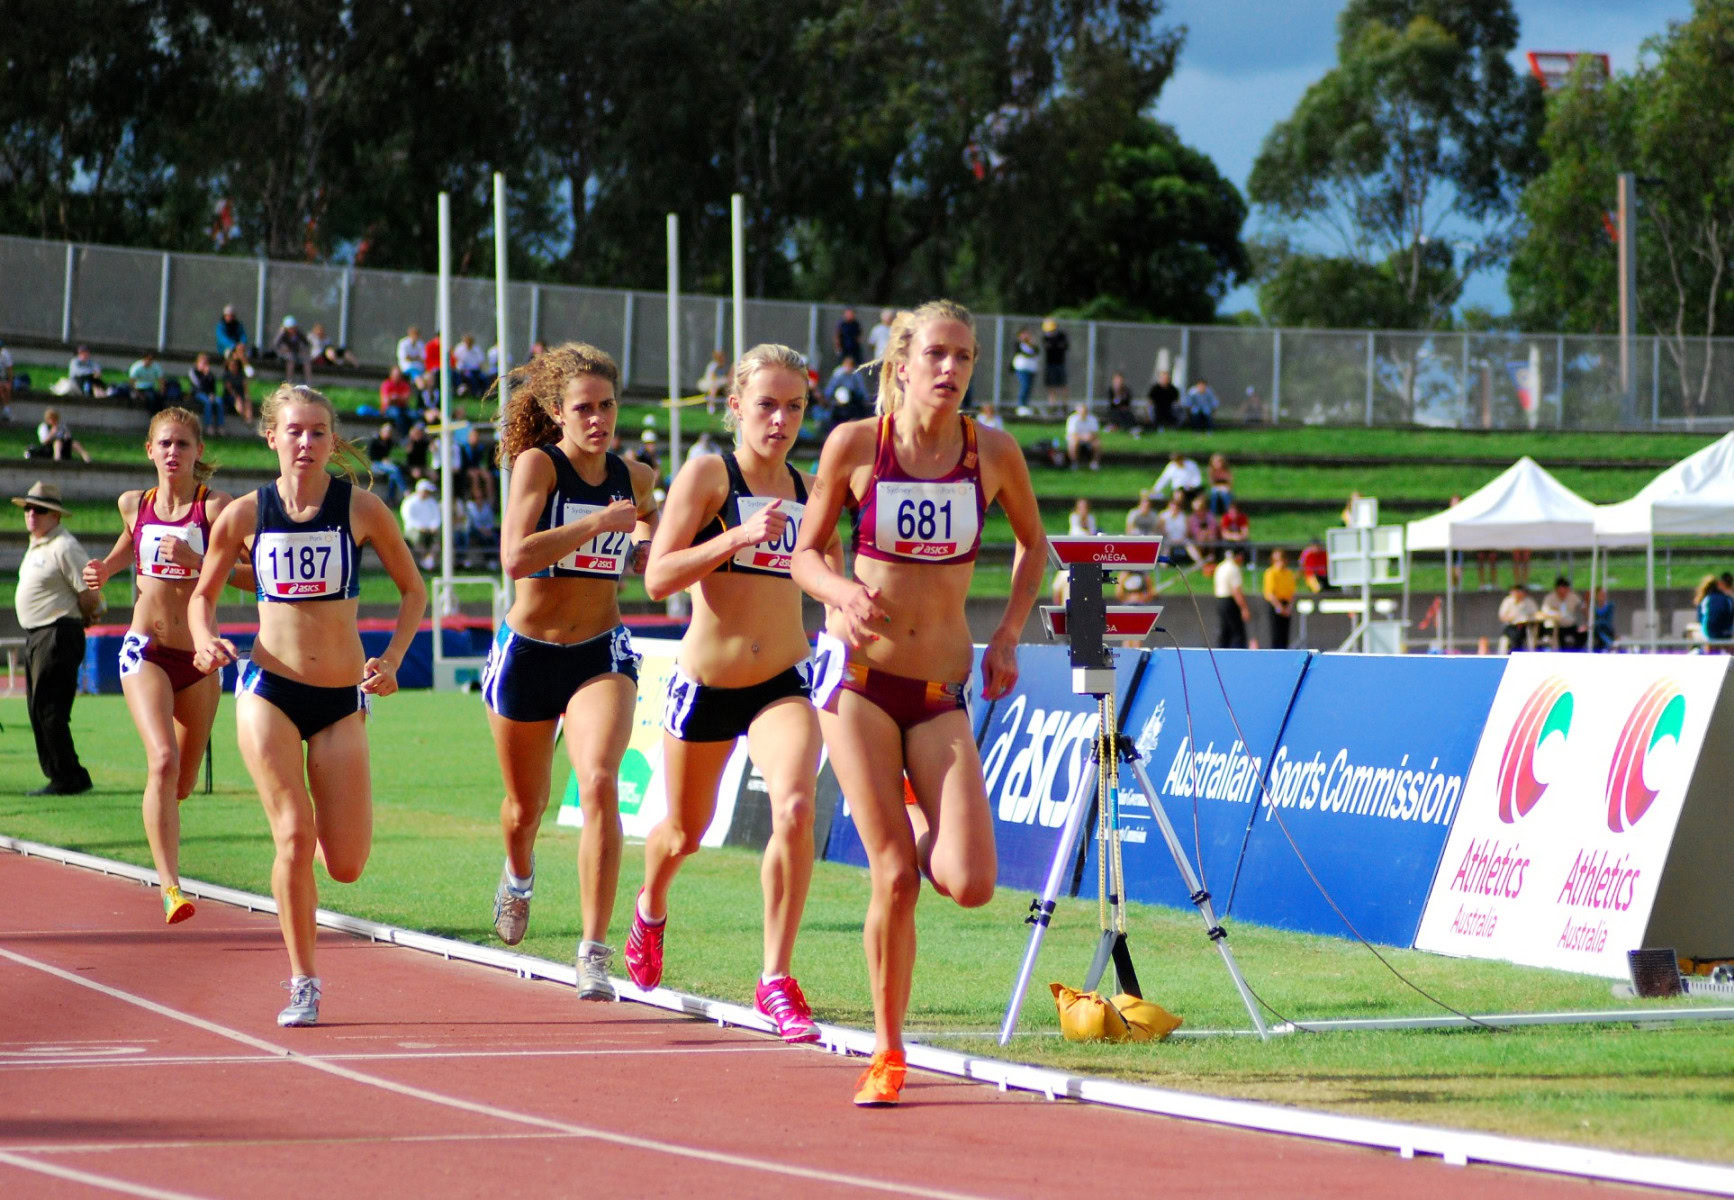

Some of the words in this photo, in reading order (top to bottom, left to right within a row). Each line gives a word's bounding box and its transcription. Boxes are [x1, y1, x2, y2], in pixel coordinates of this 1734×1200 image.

[571, 506, 593, 515] Sydney
[897, 499, 952, 541] 681
[268, 545, 332, 580] 1187
[596, 560, 613, 569] asics
[923, 545, 949, 555] asics
[1092, 553, 1128, 562] OMEGA
[168, 567, 186, 575] asics
[297, 583, 321, 593] asics
[998, 708, 1103, 829] asics
[1161, 736, 1262, 804] Australian
[1261, 744, 1327, 822] Sports
[1320, 748, 1462, 826] Commission
[1450, 837, 1530, 899] Athletics
[1556, 848, 1641, 912] Athletics
[1449, 902, 1498, 938] Australia
[1556, 915, 1609, 953] Australia
